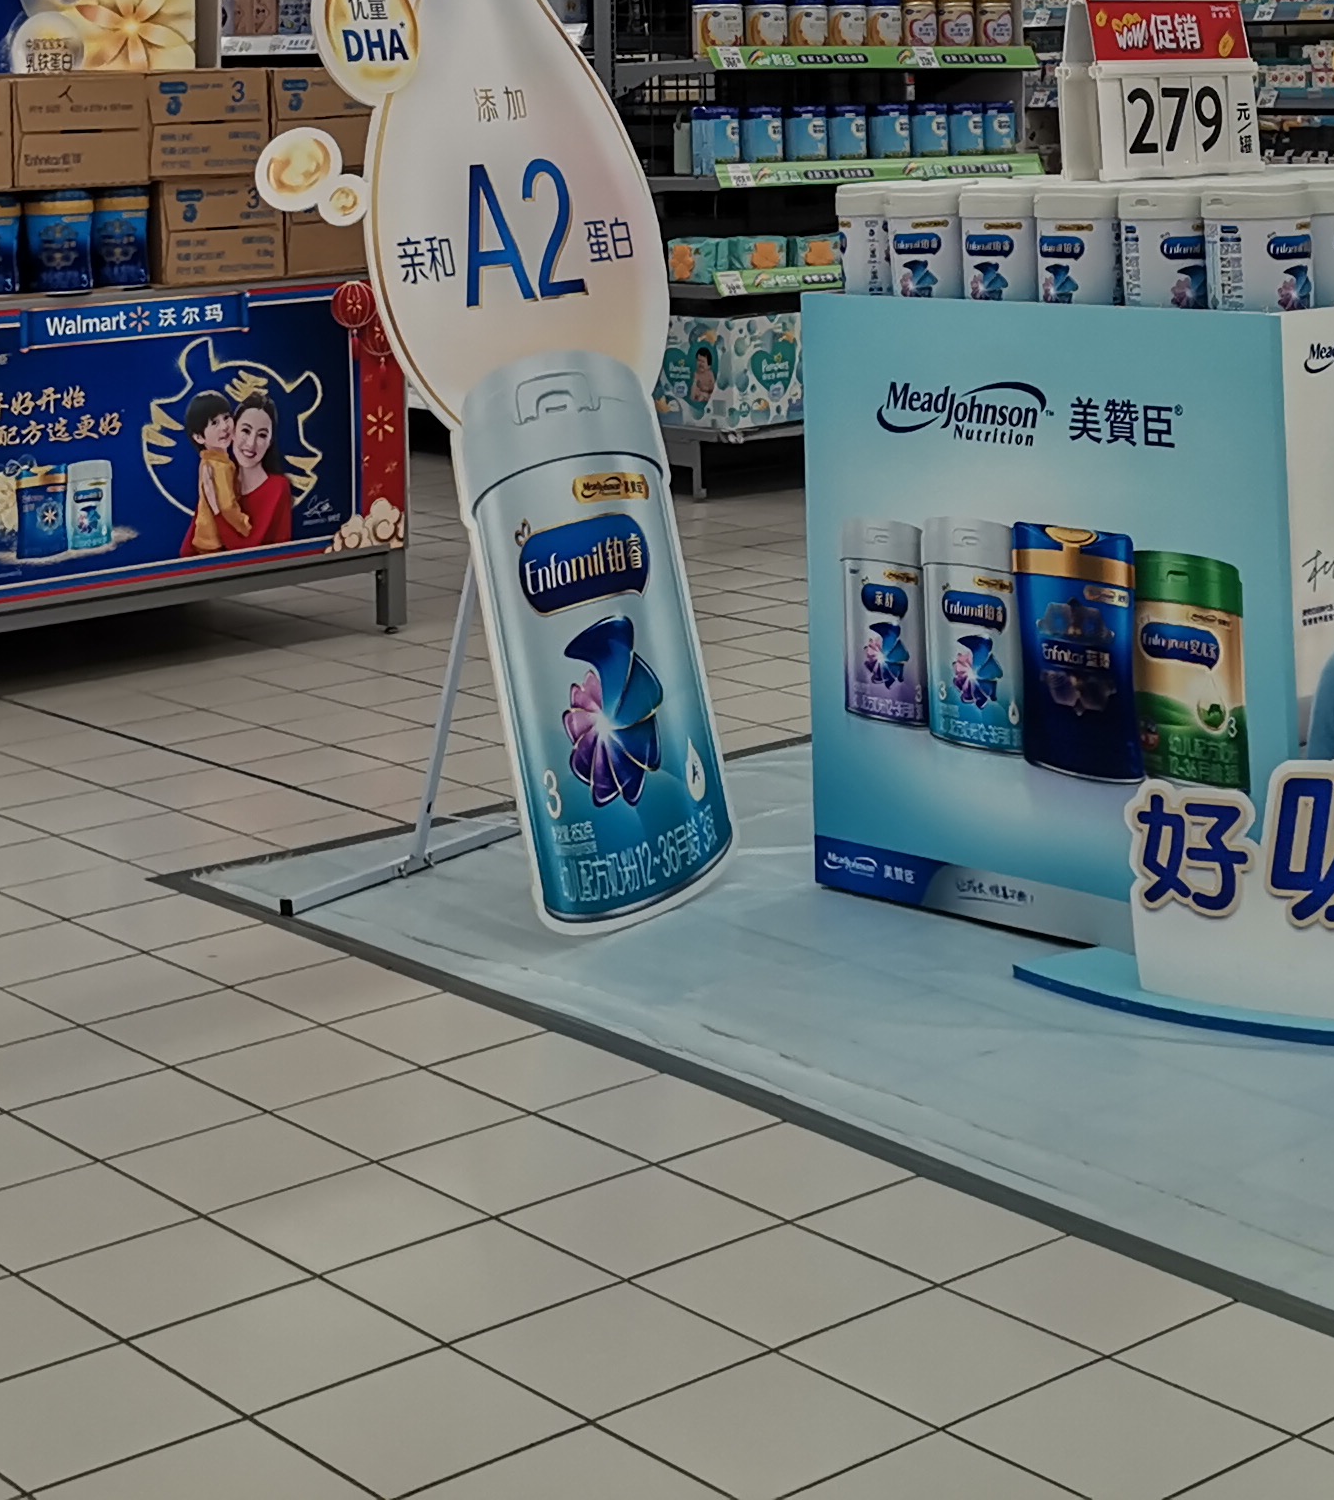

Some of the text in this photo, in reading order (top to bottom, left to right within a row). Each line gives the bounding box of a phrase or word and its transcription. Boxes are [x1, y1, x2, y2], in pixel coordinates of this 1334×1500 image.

[341, 28, 410, 63] DHA
[1149, 13, 1202, 51] 促销
[231, 79, 245, 102] 3
[472, 86, 528, 124] 添加
[1127, 85, 1223, 155] 279
[396, 157, 635, 311] 亲和 A2 蛋白
[46, 304, 224, 337] Walmart 沃尔玛
[953, 424, 1035, 447] Nutrition
[524, 533, 645, 596] Enfamil 铂睿
[937, 681, 947, 700] 3
[1227, 717, 1238, 738] 3
[543, 769, 563, 820] 3
